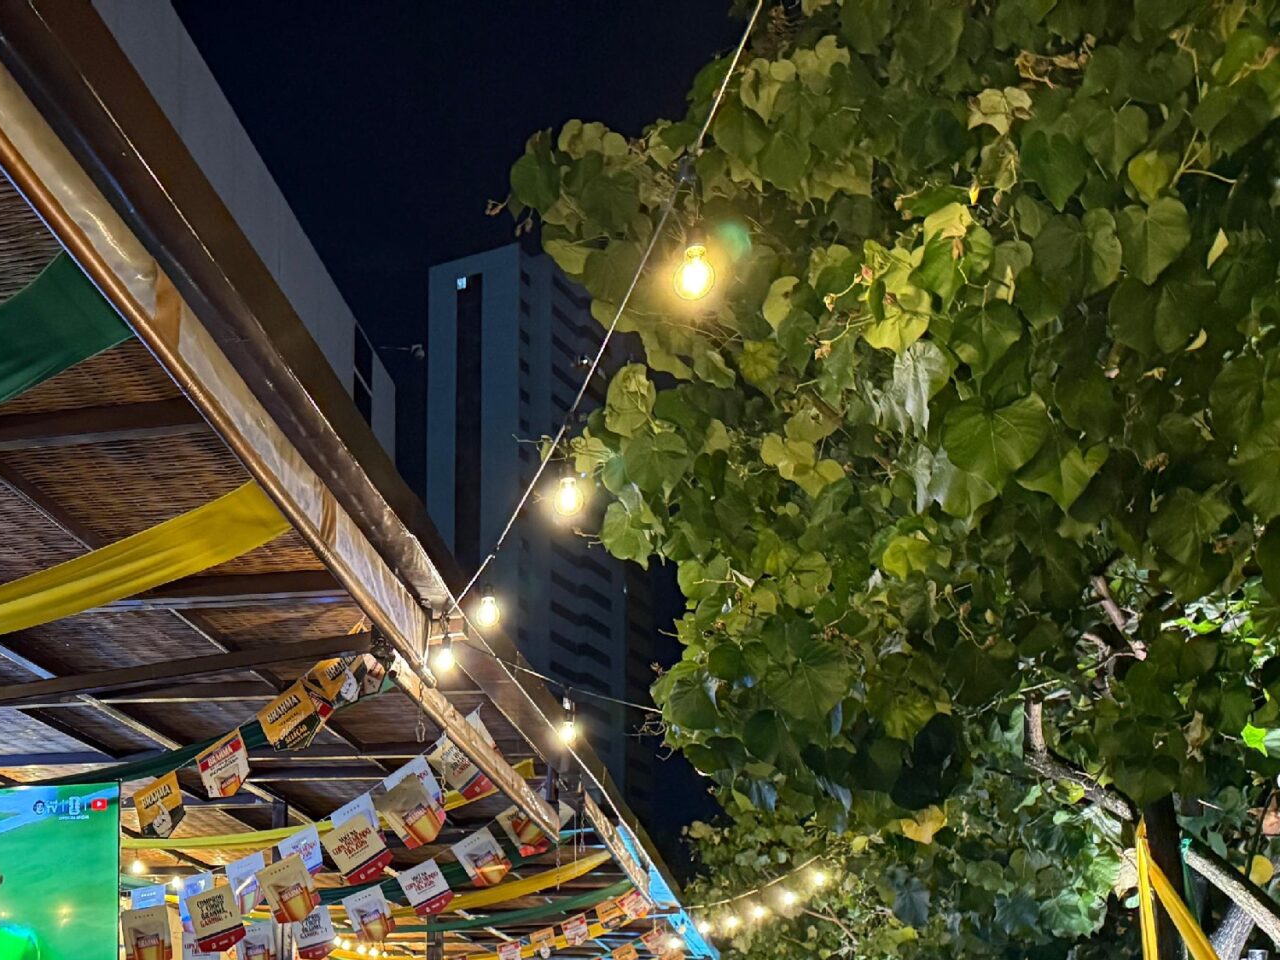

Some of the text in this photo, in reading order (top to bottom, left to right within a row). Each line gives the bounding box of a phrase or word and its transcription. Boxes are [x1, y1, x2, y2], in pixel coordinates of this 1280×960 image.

[263, 693, 301, 724] BRAHMA
[205, 744, 234, 766] BRAHMA
[138, 782, 173, 809] BRAHMA
